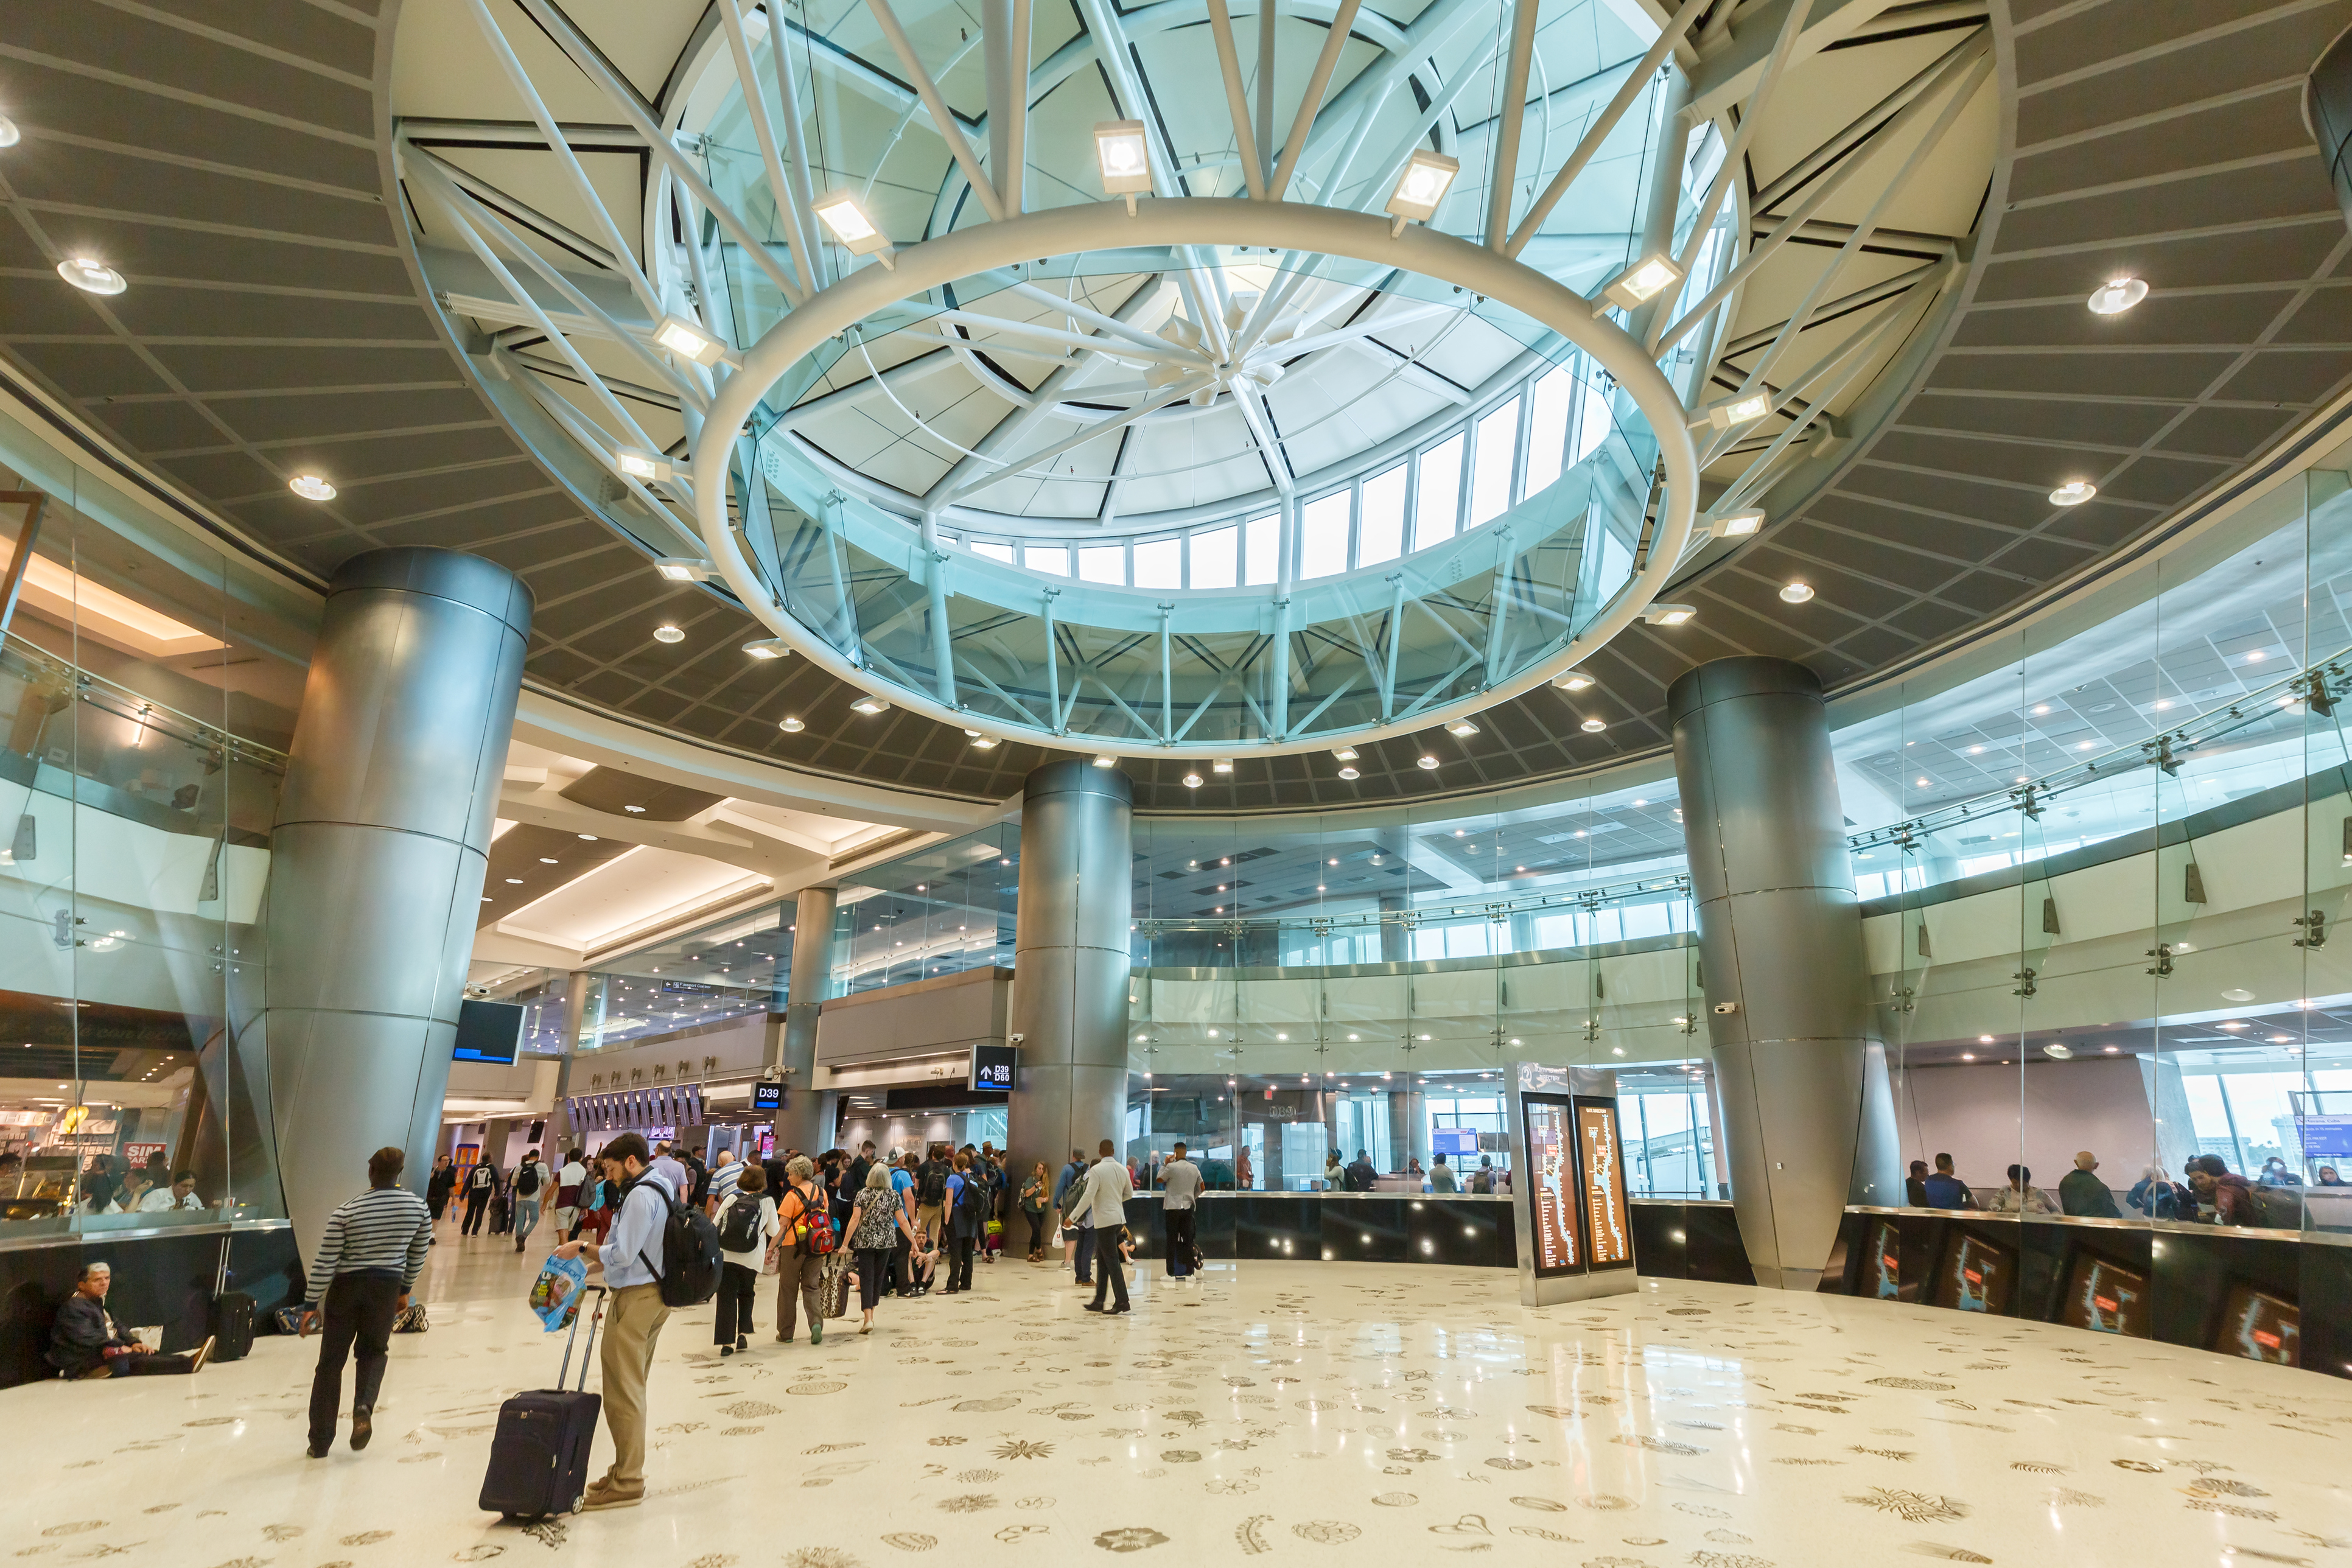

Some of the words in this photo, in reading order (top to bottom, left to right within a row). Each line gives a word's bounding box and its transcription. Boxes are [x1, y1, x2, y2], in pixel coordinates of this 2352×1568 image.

[995, 1065, 1009, 1073] D39
[759, 1088, 779, 1098] D39
[127, 1146, 161, 1157] SIM
